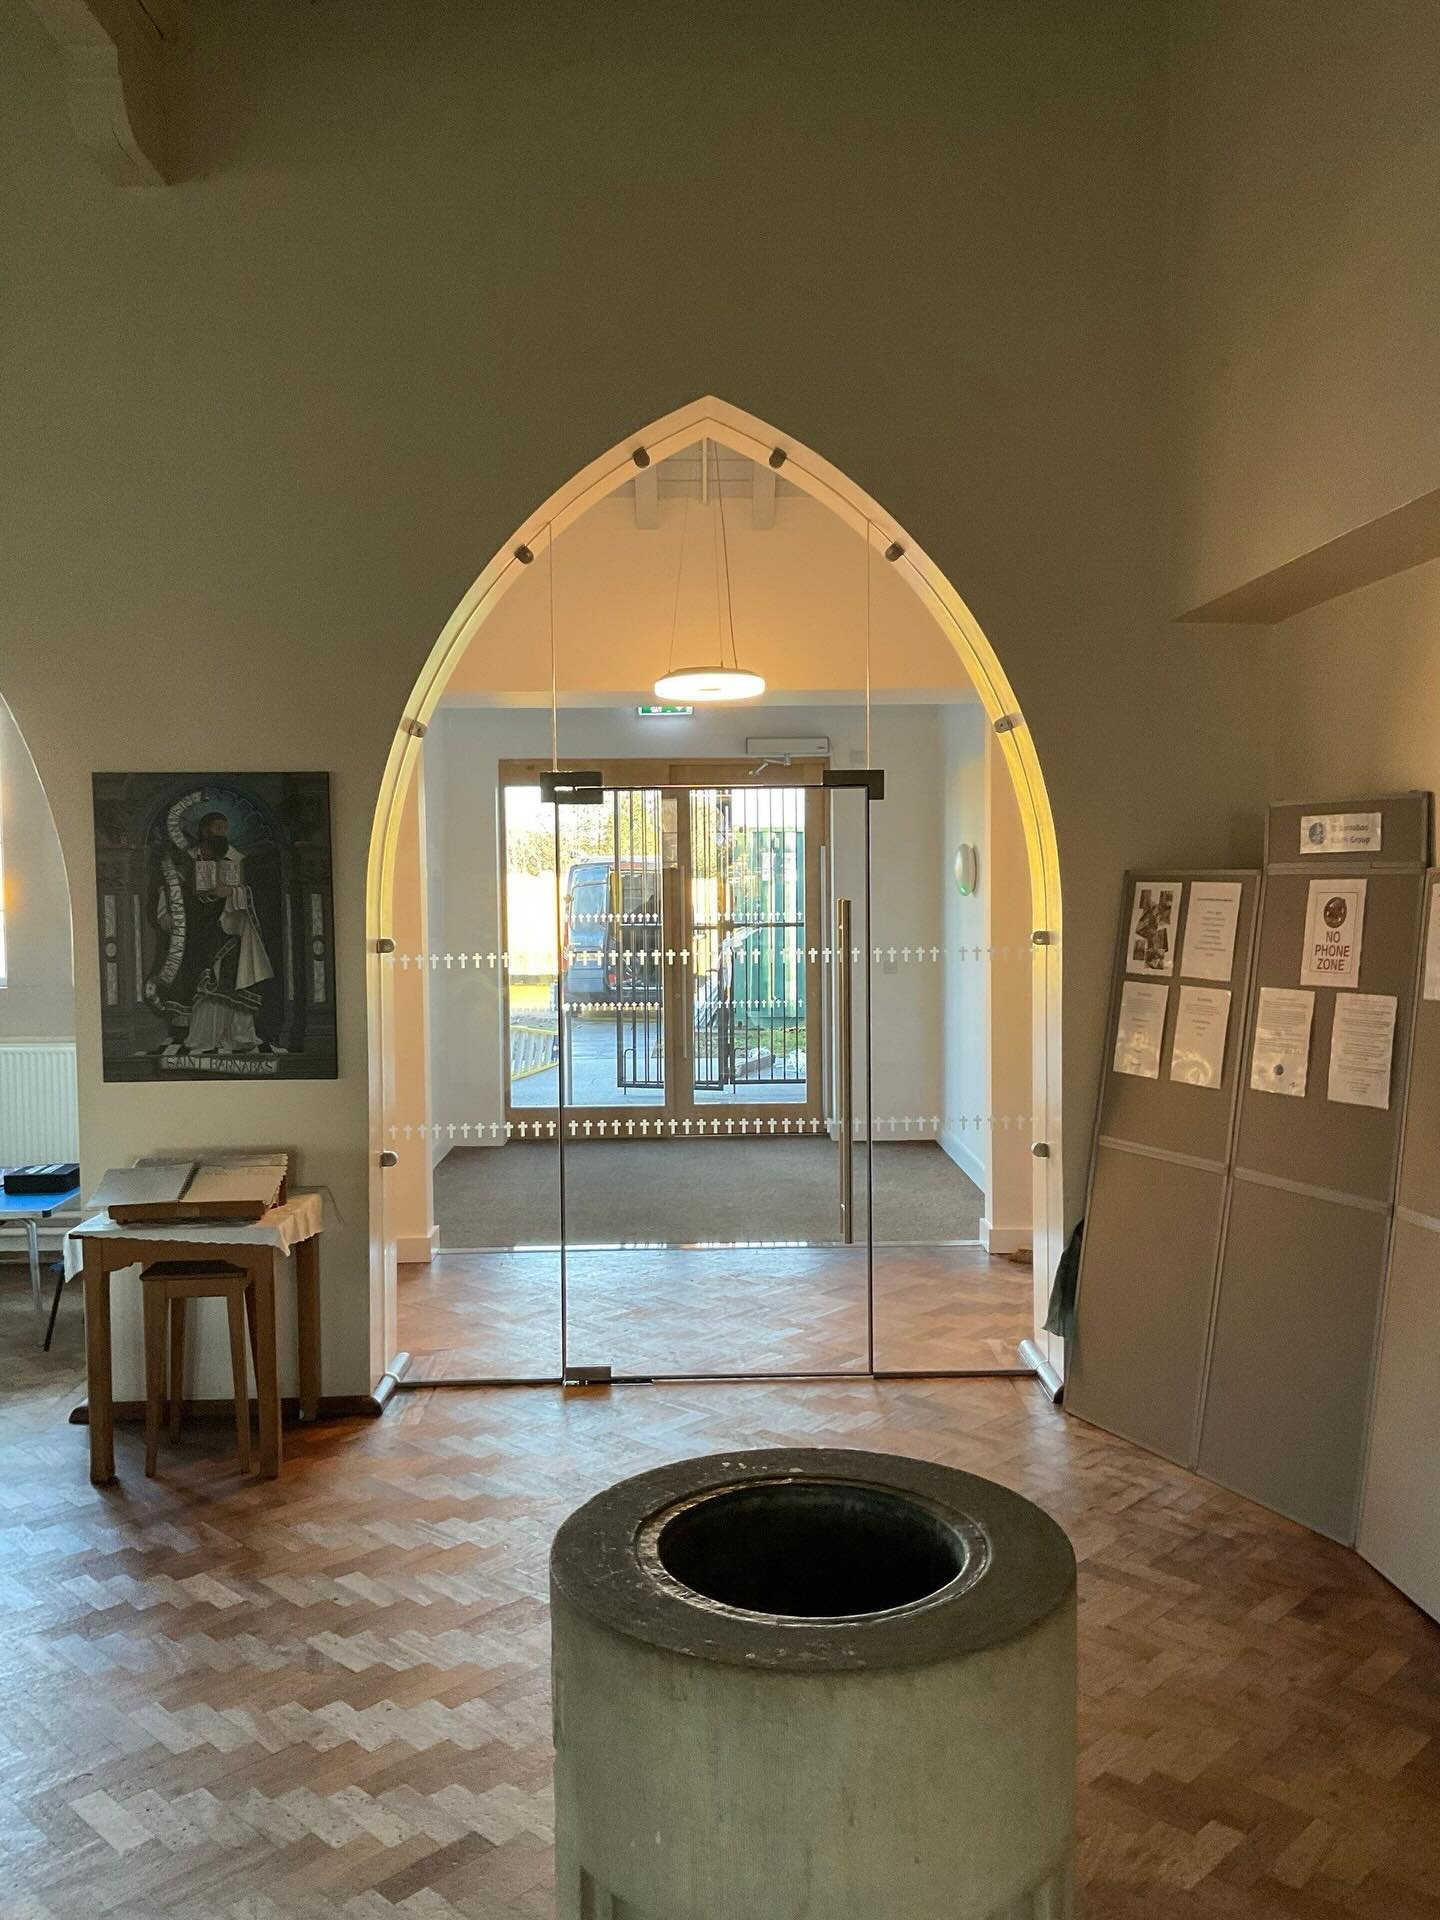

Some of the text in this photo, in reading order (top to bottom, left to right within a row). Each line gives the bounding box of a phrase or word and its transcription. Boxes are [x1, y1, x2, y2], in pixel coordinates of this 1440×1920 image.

[1325, 930, 1341, 943] NO
[1314, 944, 1350, 957] PHONE
[1317, 958, 1345, 971] ZONE
[167, 1055, 205, 1070] SAINT
